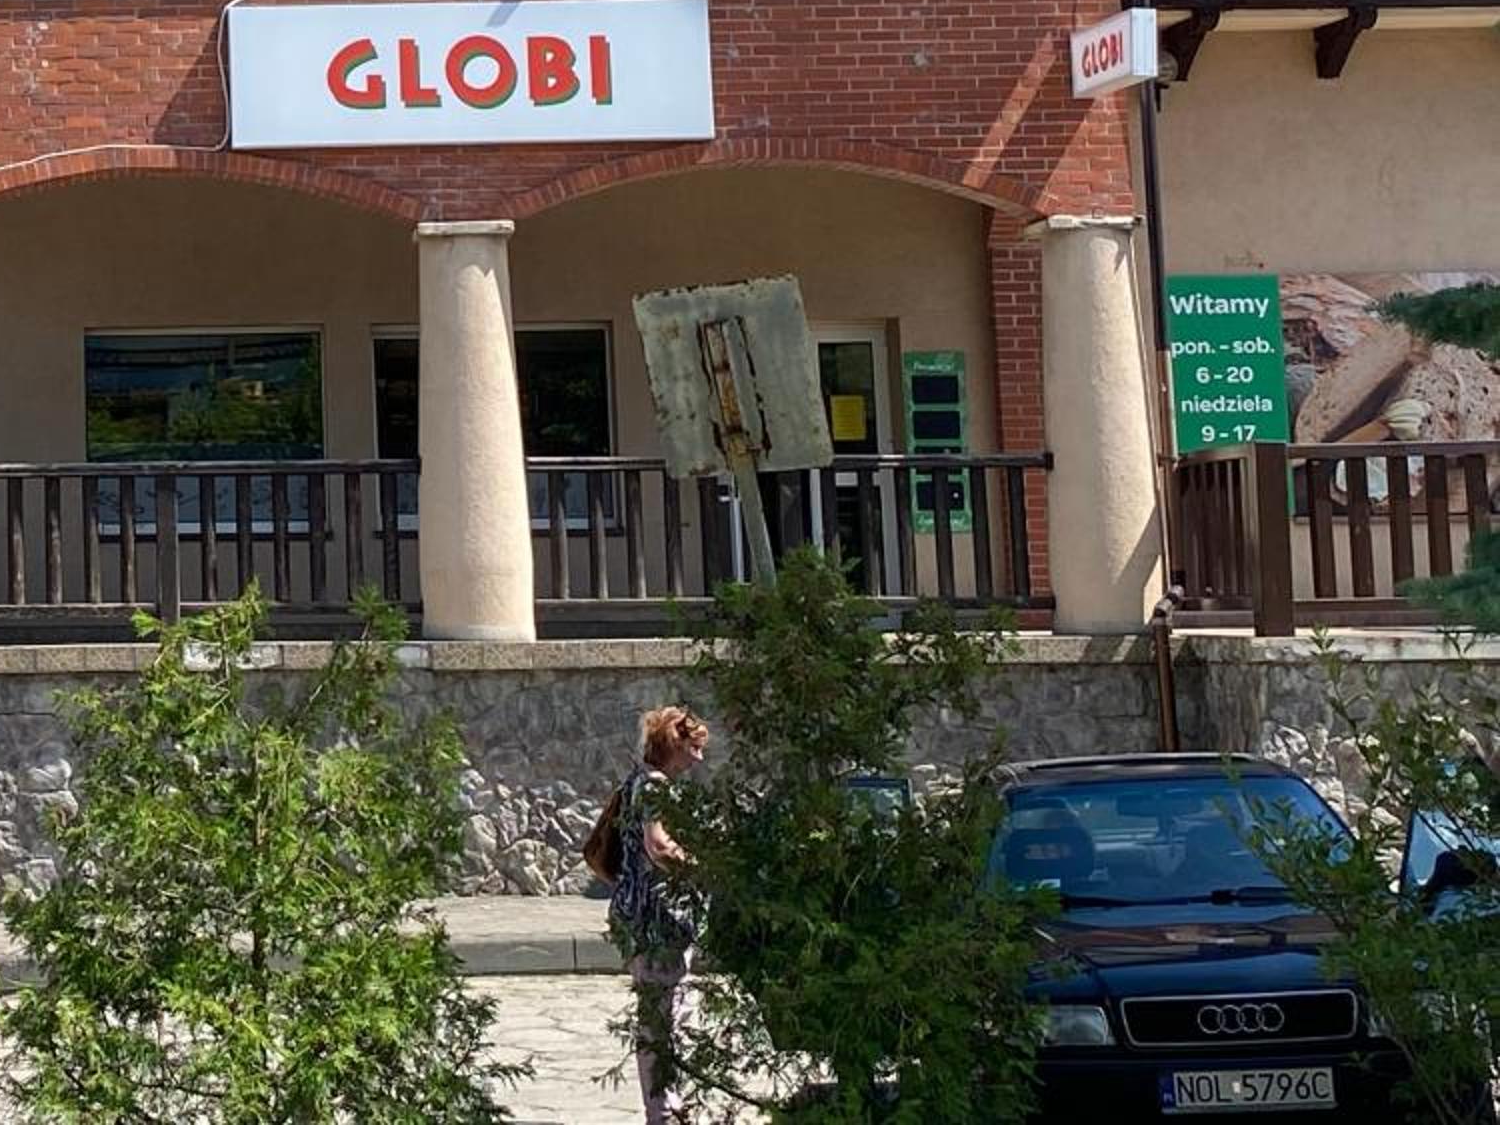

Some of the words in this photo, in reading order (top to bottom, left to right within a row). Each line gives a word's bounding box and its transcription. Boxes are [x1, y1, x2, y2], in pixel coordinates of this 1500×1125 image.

[1082, 30, 1124, 78] GLOBI
[326, 34, 613, 110] GLOBI
[1169, 293, 1269, 318] Witamy
[1171, 340, 1216, 358] pon.
[1232, 336, 1275, 354] sob.
[1227, 366, 1253, 383] 20
[1181, 395, 1273, 412] niedziela
[1232, 424, 1256, 442] 17
[1176, 1075, 1233, 1103] NOL
[1241, 1071, 1330, 1101] 5796C
